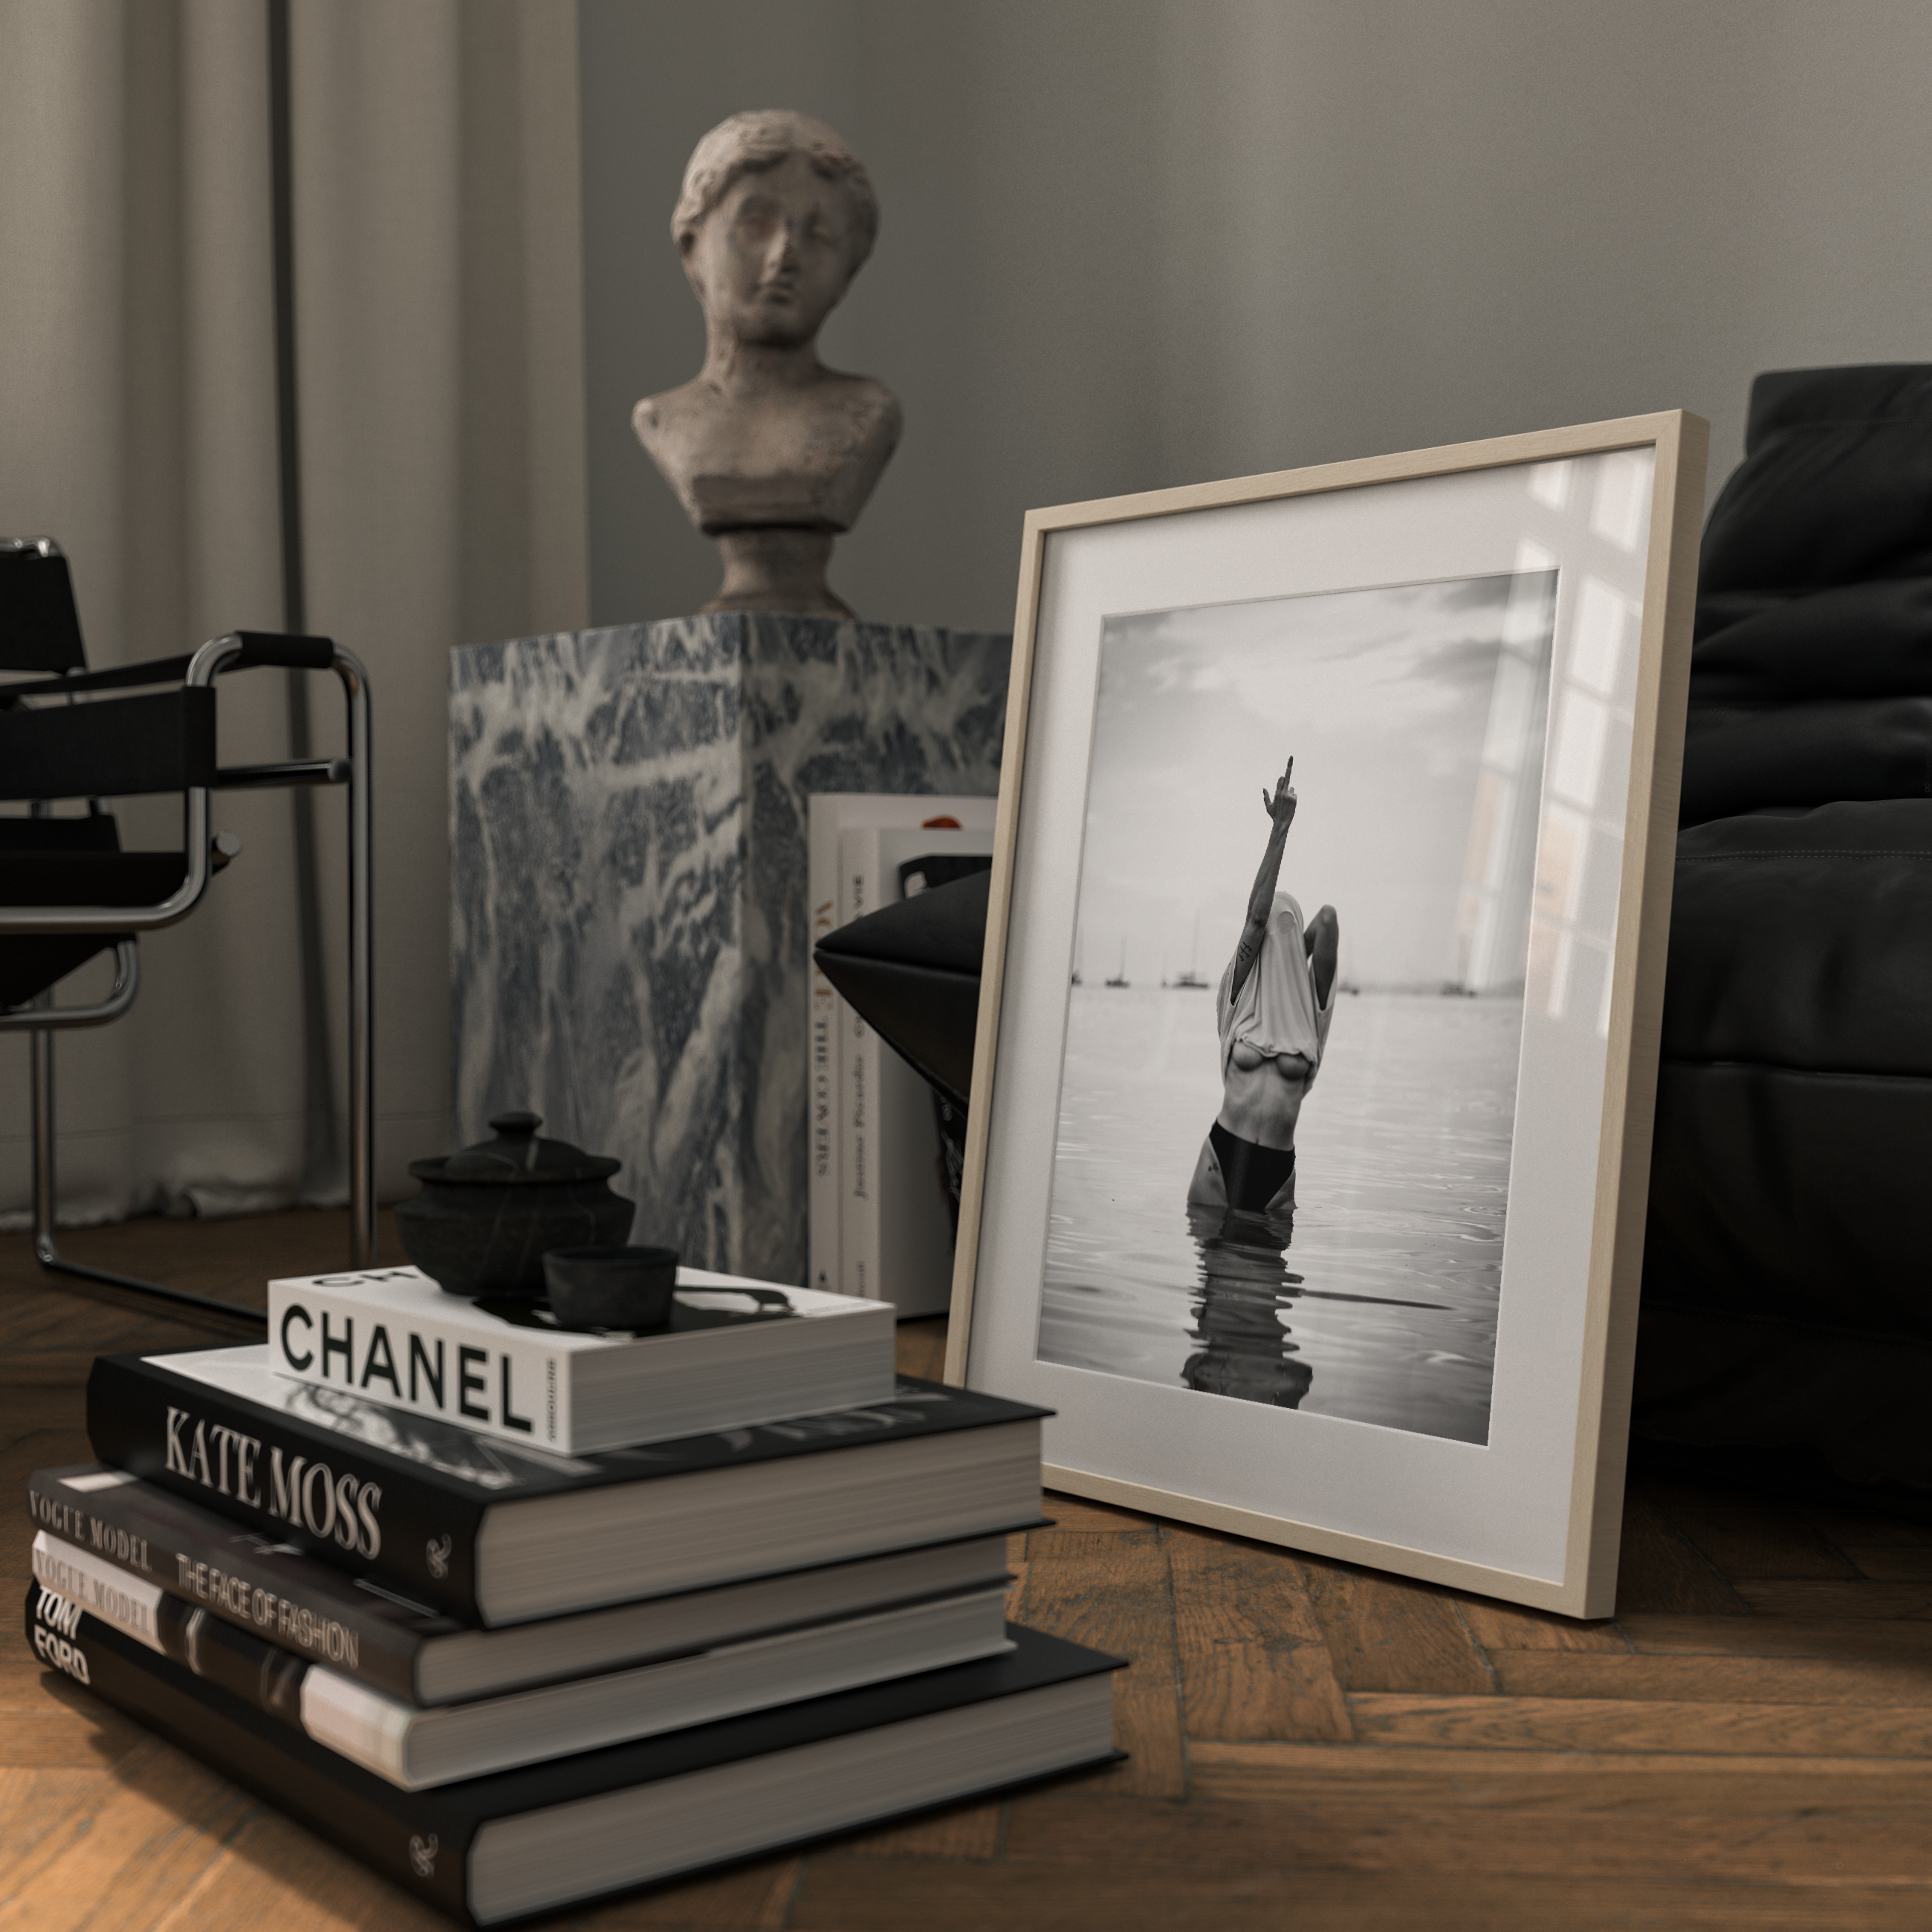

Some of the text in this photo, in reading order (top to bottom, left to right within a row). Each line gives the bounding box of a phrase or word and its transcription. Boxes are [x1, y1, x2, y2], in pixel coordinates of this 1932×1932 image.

[814, 1015, 830, 1072] THE
[815, 1075, 831, 1177] COVERS
[281, 1303, 534, 1434] CHANEL
[165, 1406, 383, 1560] KATE MOSS
[30, 1489, 152, 1572] VOGUE MODEL
[35, 1549, 153, 1636] VOGUE MODEL
[36, 1585, 84, 1639] TOM
[175, 1553, 359, 1670] THE FACE OF FASHION
[34, 1624, 91, 1685] FORD
